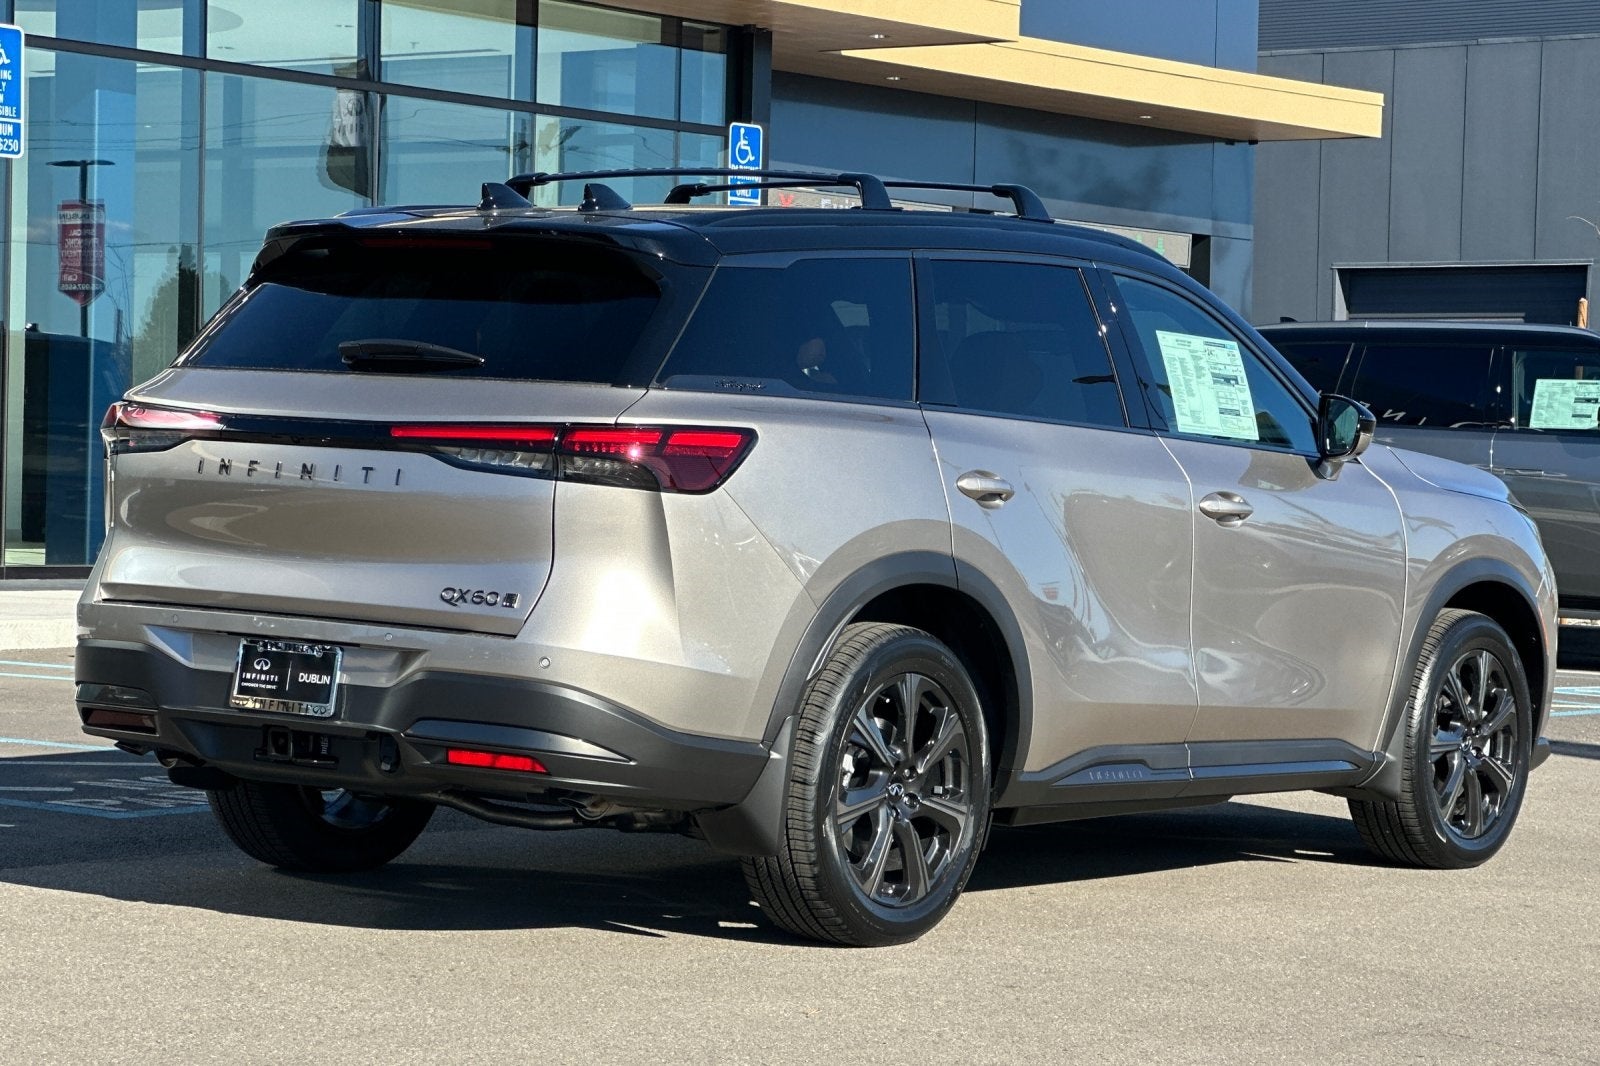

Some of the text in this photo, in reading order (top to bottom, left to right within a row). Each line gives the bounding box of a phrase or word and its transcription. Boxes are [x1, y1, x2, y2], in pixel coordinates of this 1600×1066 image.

[197, 457, 402, 486] INFINITI
[440, 587, 500, 607] QX60
[242, 672, 279, 682] INFINITI
[298, 672, 331, 685] DUBLIN
